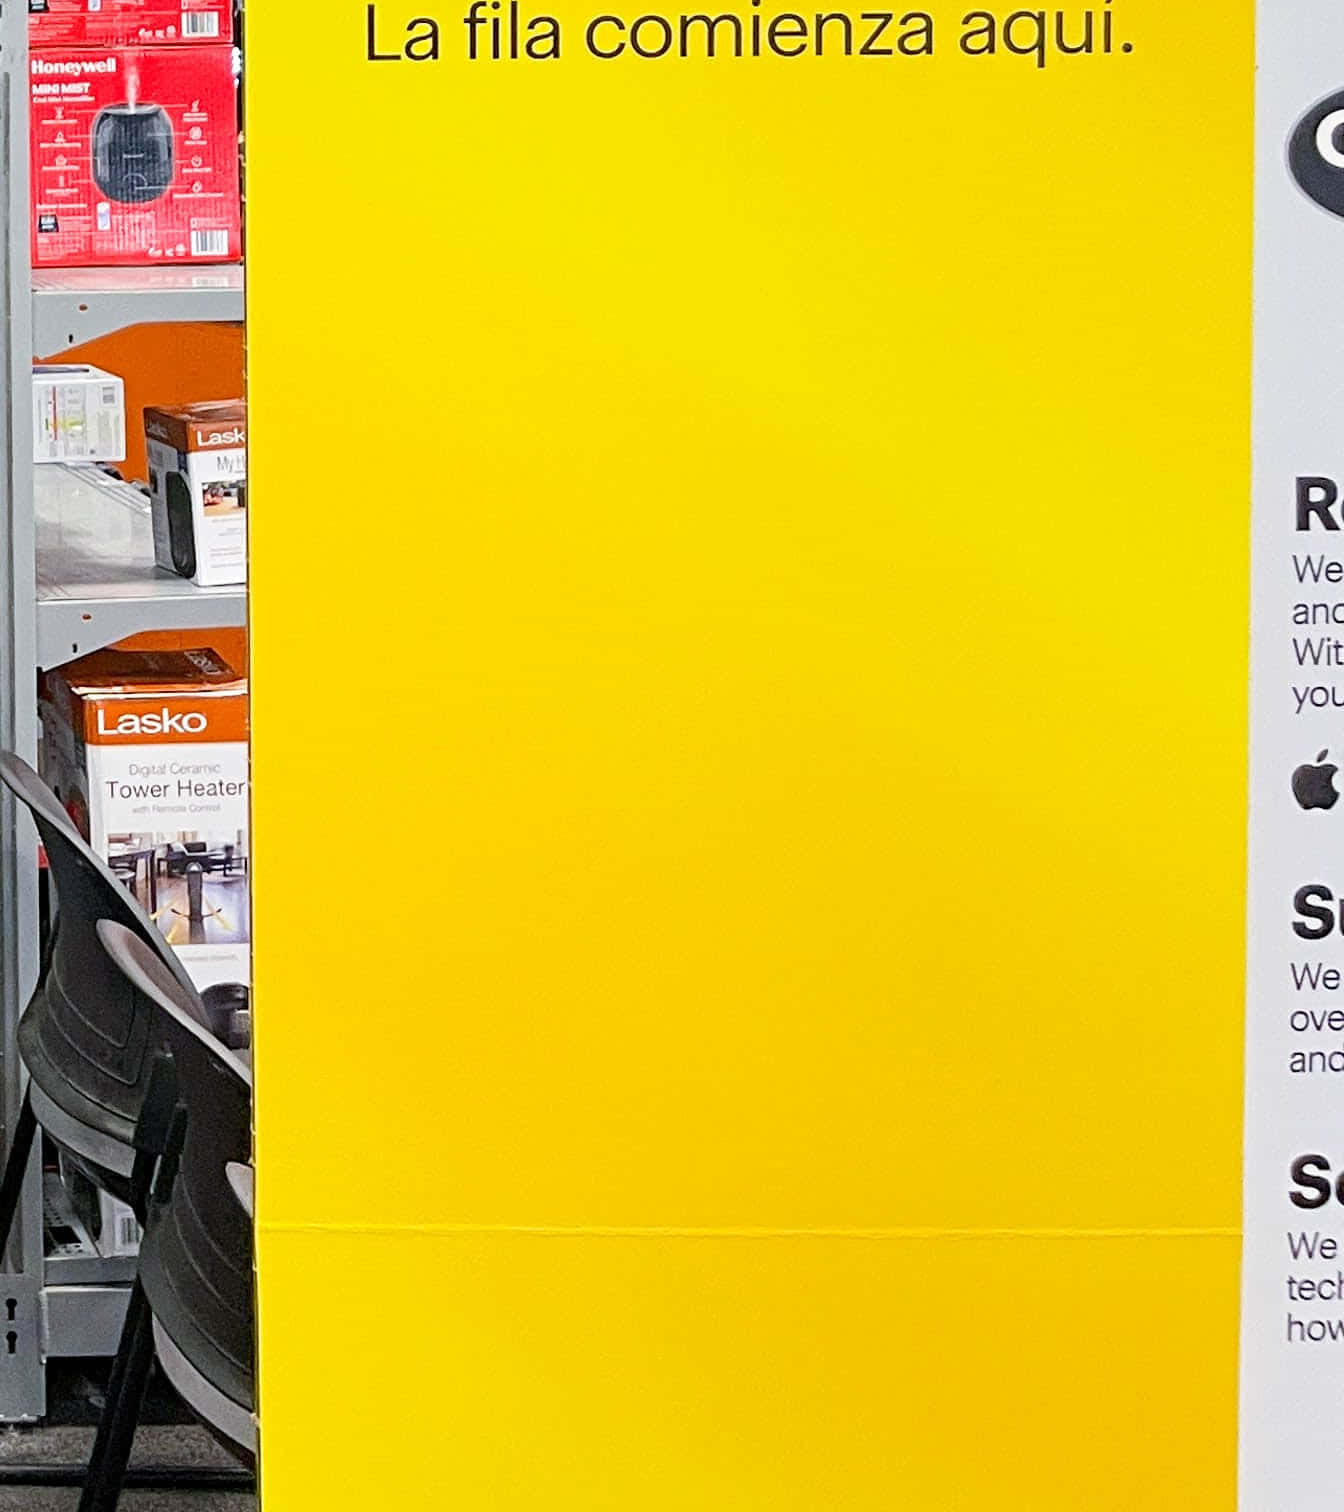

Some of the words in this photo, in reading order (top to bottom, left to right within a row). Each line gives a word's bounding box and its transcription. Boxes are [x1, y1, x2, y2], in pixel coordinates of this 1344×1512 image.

[366, 3, 441, 62] La
[464, 0, 562, 60] fila
[31, 57, 117, 76] Honeywell
[197, 427, 245, 447] Lask
[1295, 476, 1344, 532] R
[97, 707, 208, 736] Lasko
[106, 780, 172, 800] Tower
[177, 779, 245, 798] Heater
[1291, 884, 1344, 941] S
[1291, 962, 1341, 990] We
[1289, 1153, 1344, 1210] S
[1288, 1231, 1337, 1261] We
